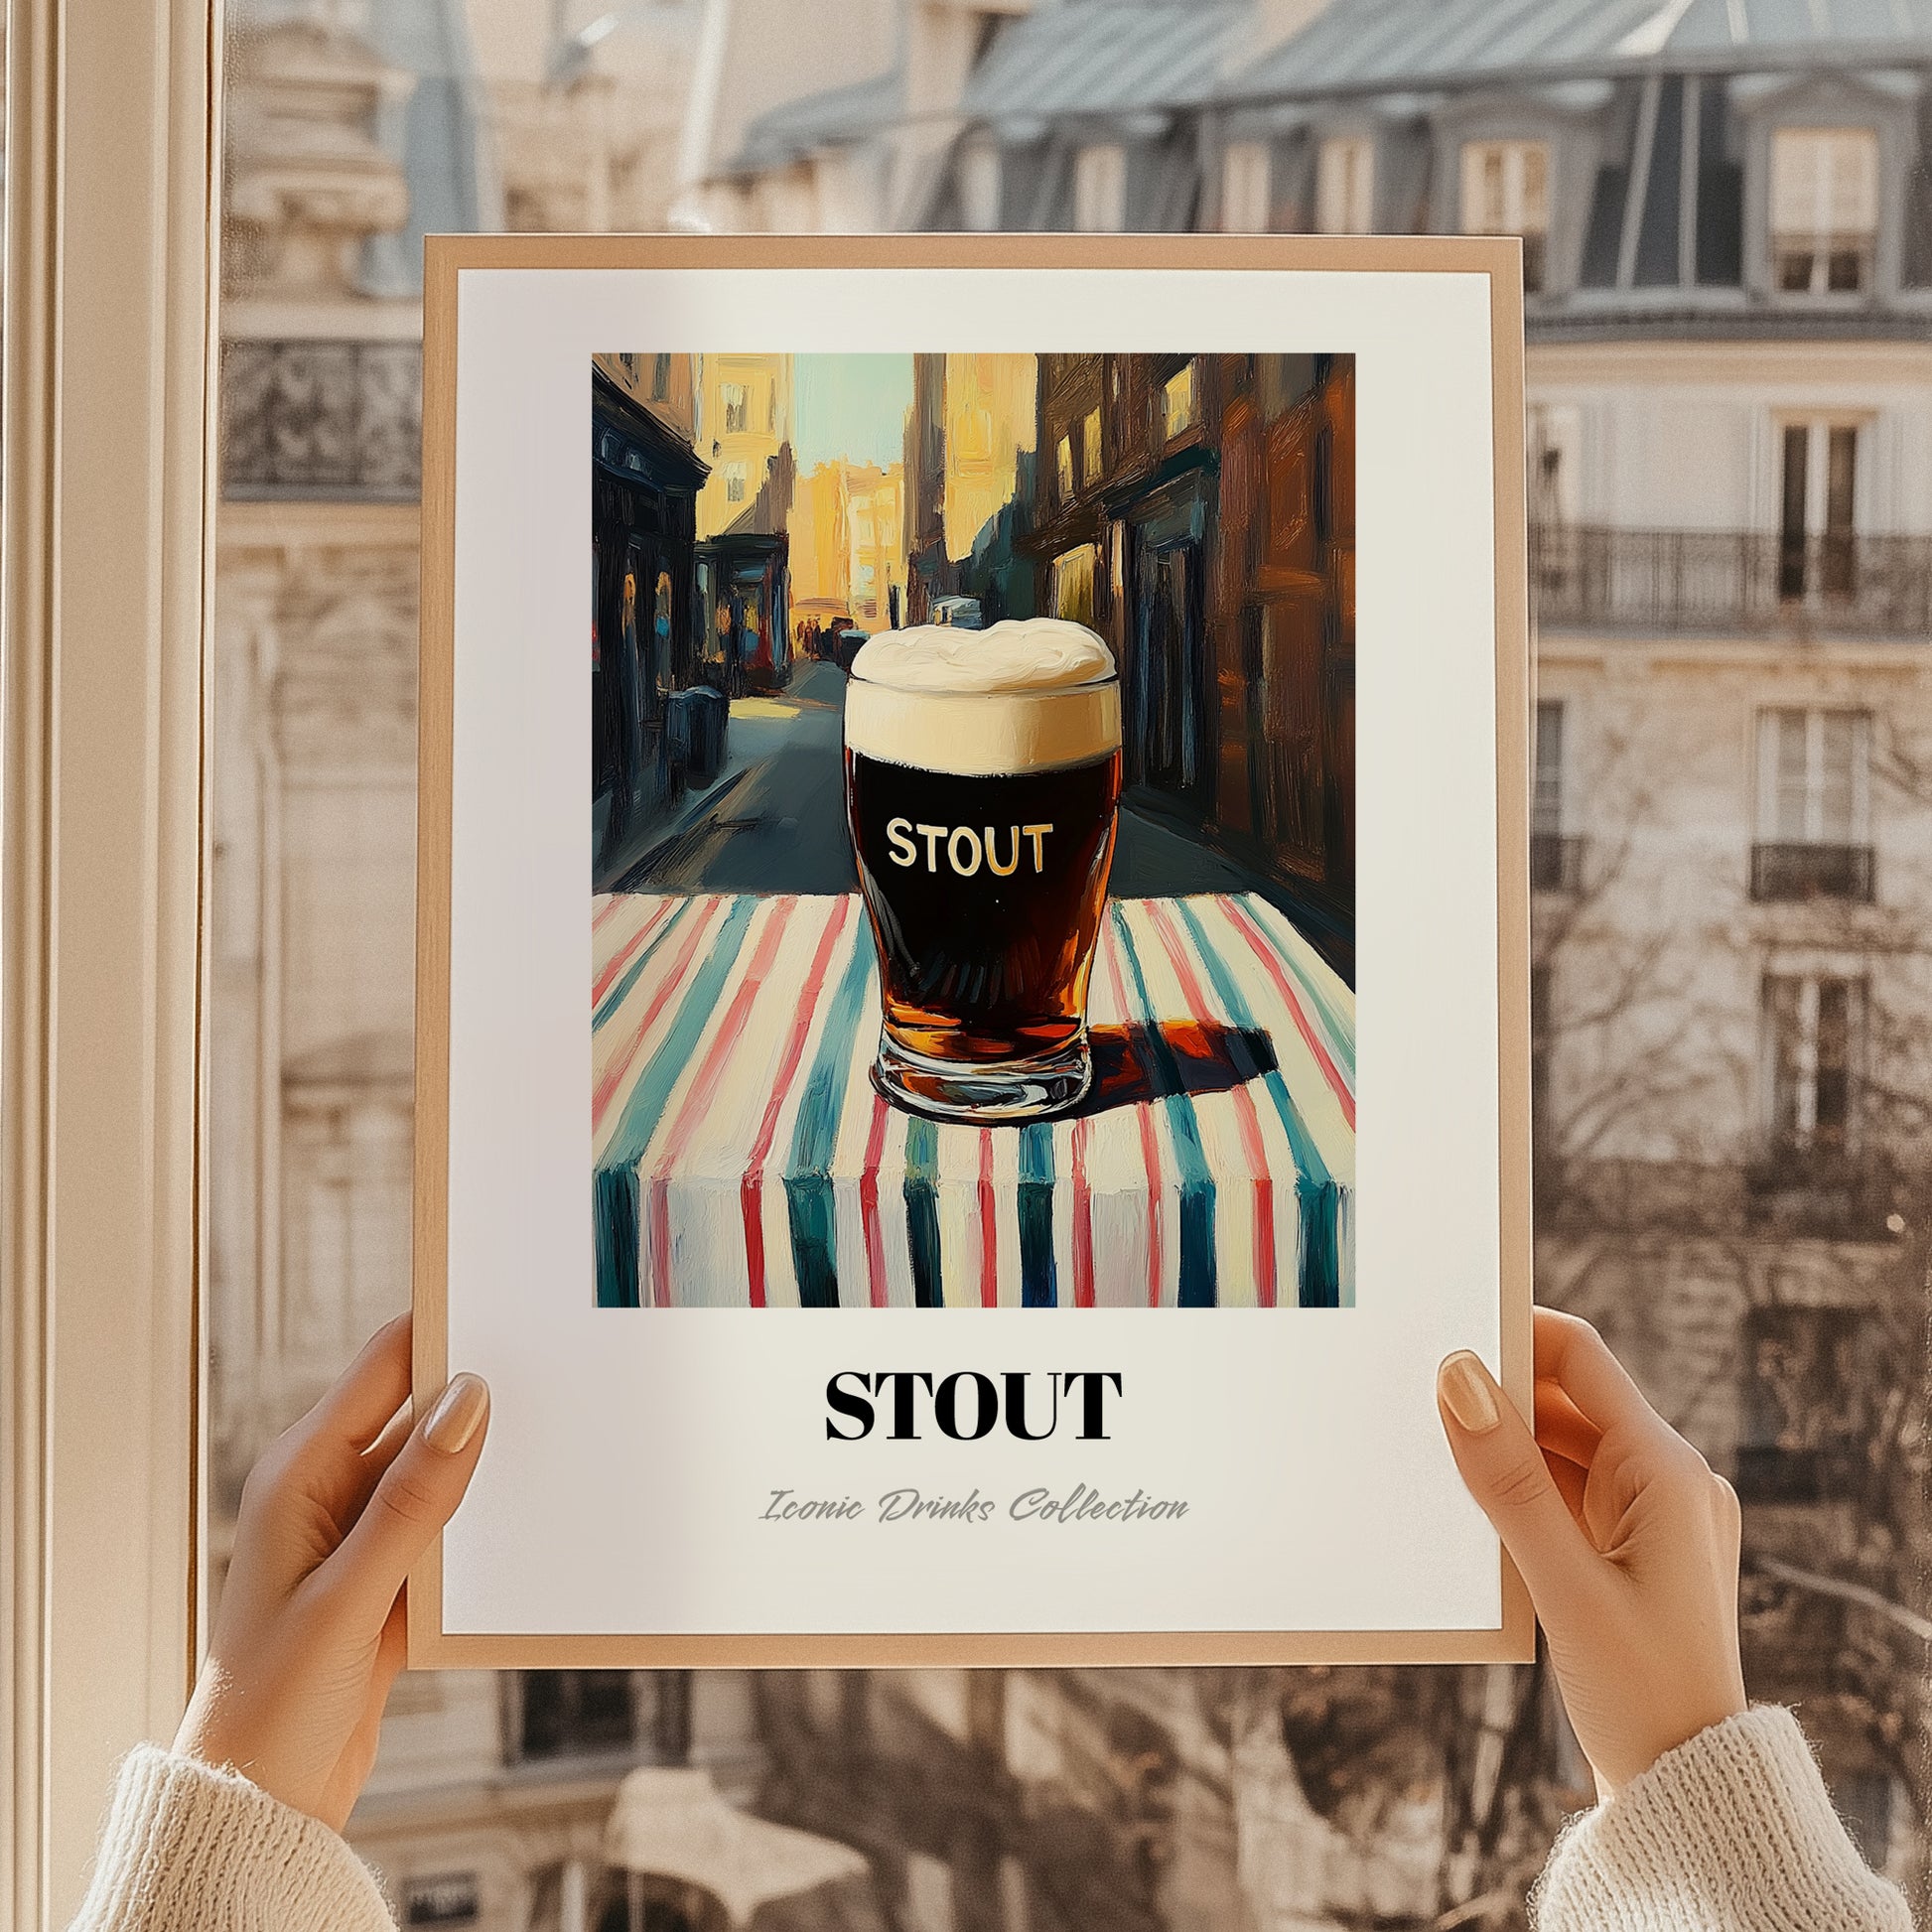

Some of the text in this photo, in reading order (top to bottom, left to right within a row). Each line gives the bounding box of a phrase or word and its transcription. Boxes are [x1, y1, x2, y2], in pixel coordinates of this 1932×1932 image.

[887, 818, 1053, 876] STOUT
[826, 1371, 1123, 1441] STOUT
[758, 1482, 1189, 1523] Iconic Drinks Collection
